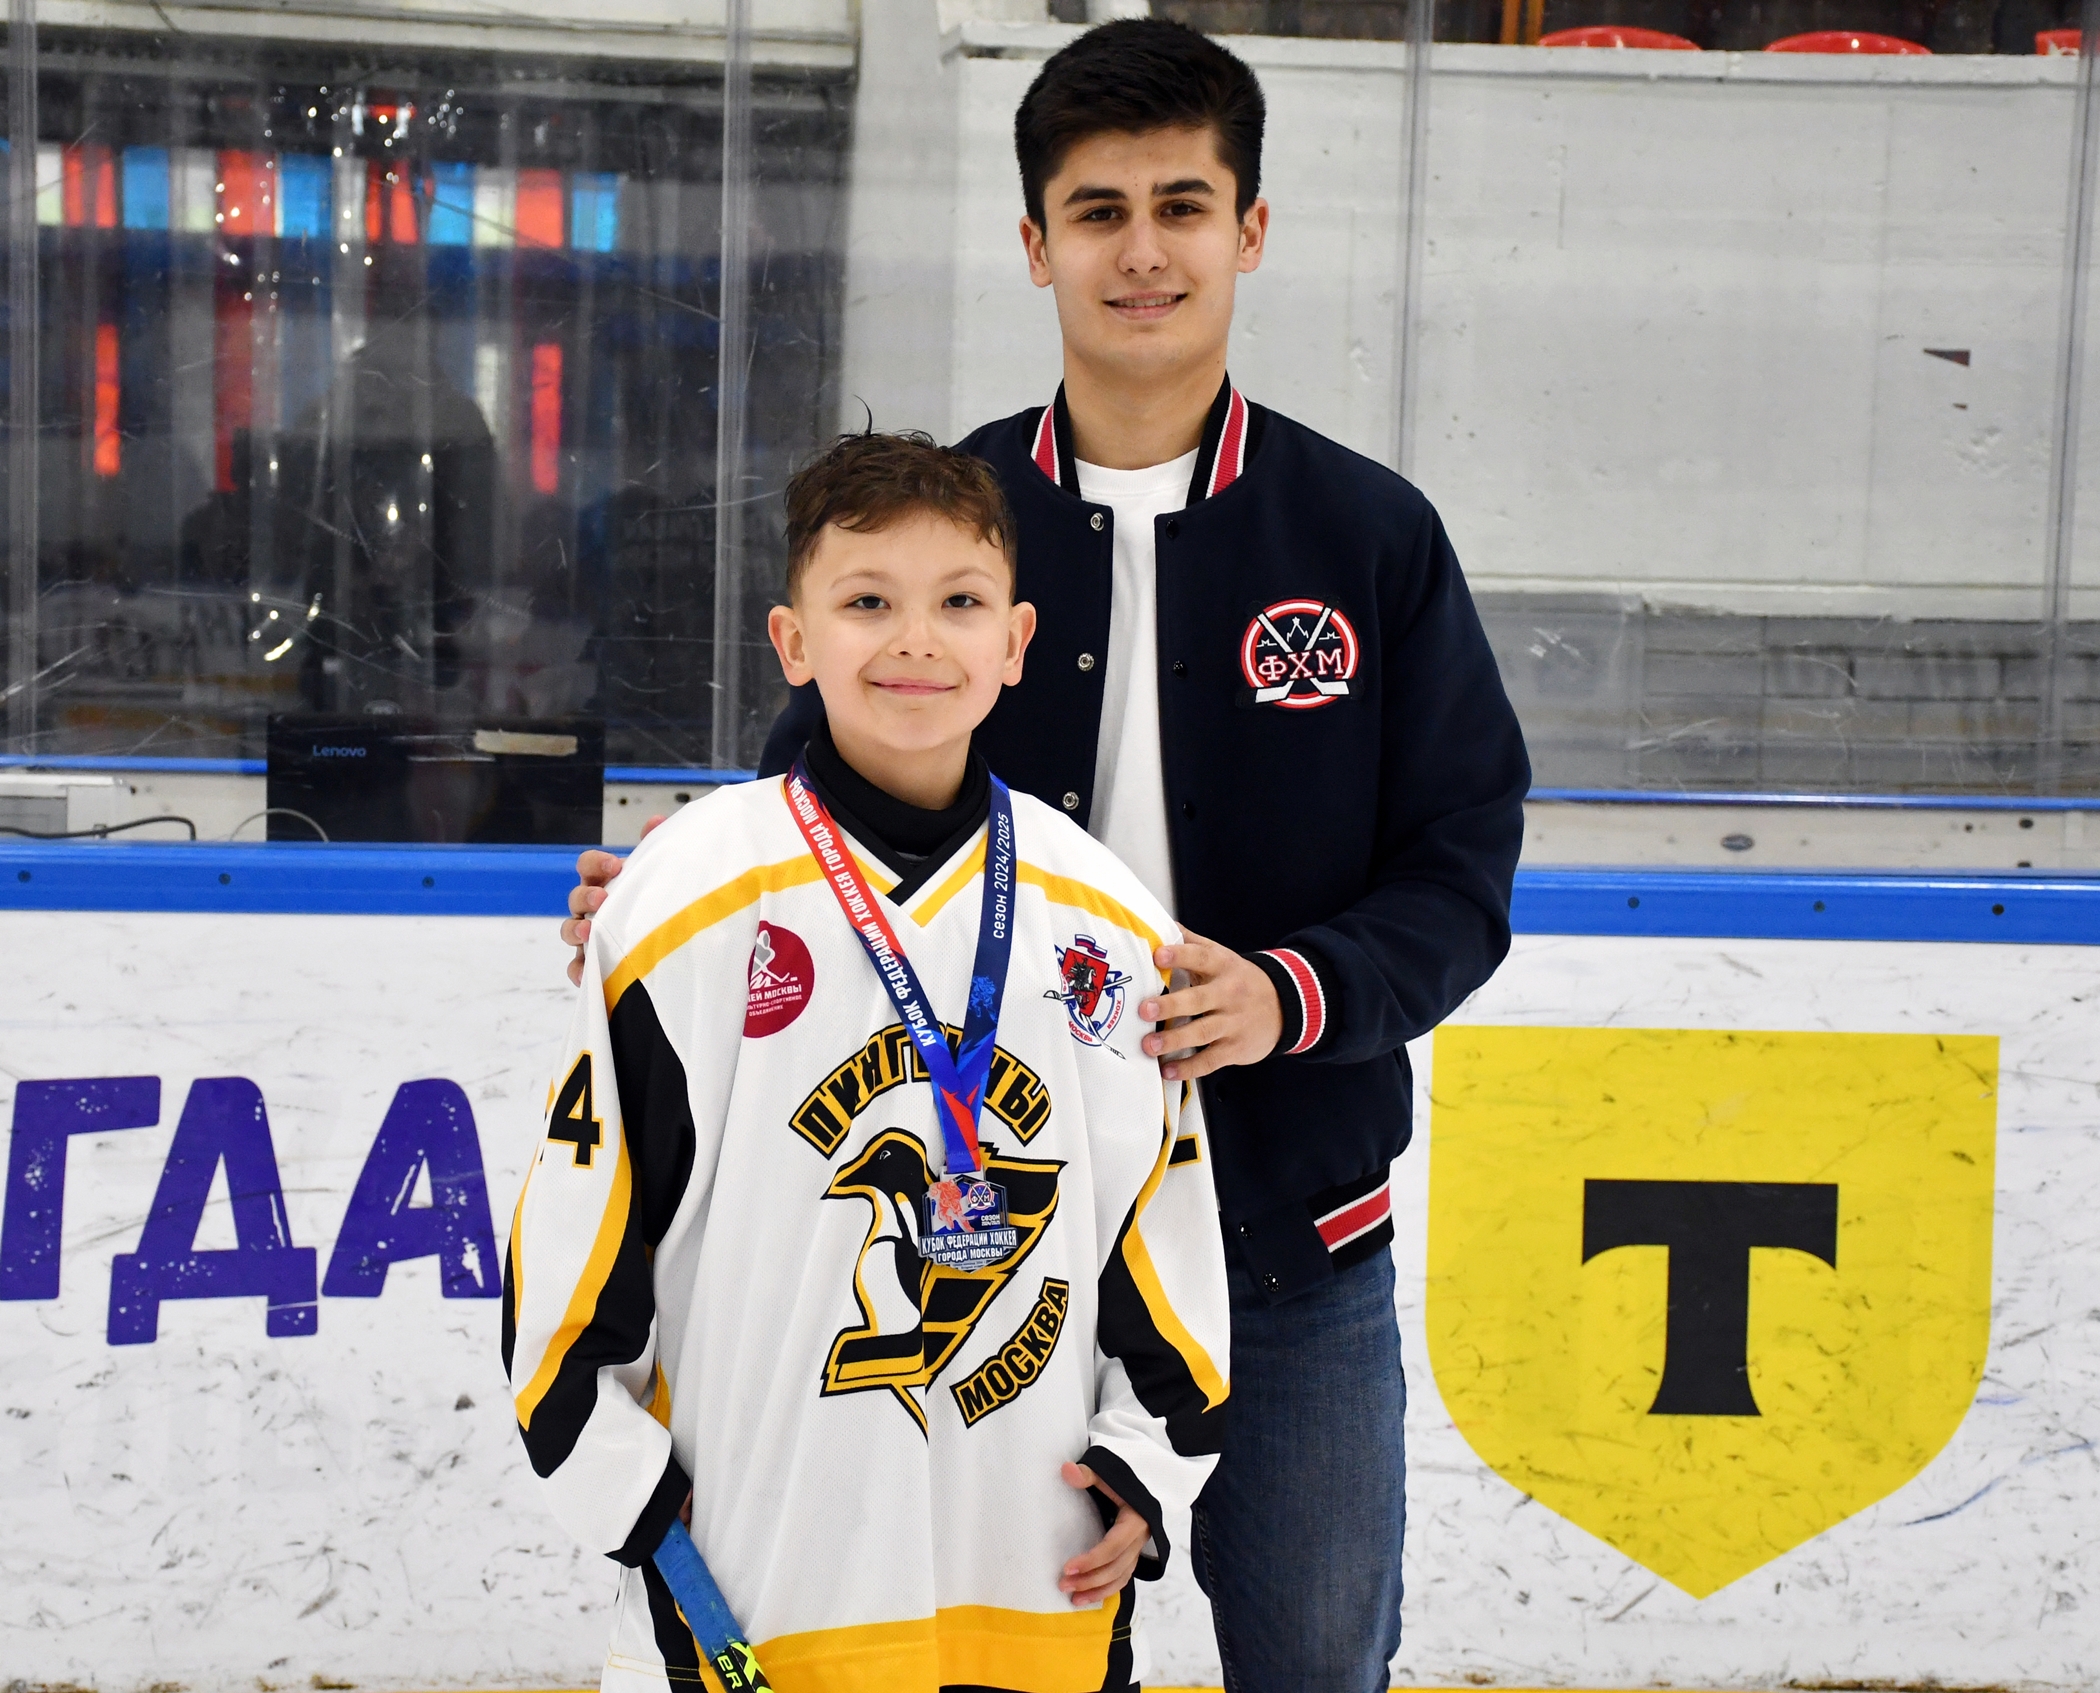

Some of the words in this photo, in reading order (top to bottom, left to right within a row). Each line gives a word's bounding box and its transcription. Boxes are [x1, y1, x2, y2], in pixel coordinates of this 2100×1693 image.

[1258, 647, 1345, 681] ФХМ
[312, 744, 368, 758] Lenovo
[788, 775, 820, 826] МОСКВЫ
[808, 822, 846, 872] ГОРОДА
[993, 811, 1011, 892] 2024/2025
[834, 871, 873, 923] ХОККЕЯ
[861, 921, 912, 1000] ФЕДЕРАЦИИ
[764, 984, 802, 999] МОСКВЫ
[902, 999, 938, 1047] КУБОК
[922, 1237, 945, 1254] КУБОК
[947, 1232, 988, 1249] ФЕДЕРАЦИИ
[990, 1230, 1017, 1246] ХОККЕЯ
[938, 1249, 968, 1263] ГОРОДА
[970, 1247, 1003, 1259] МОСКВЫ
[954, 1281, 1069, 1425] МОСКВА
